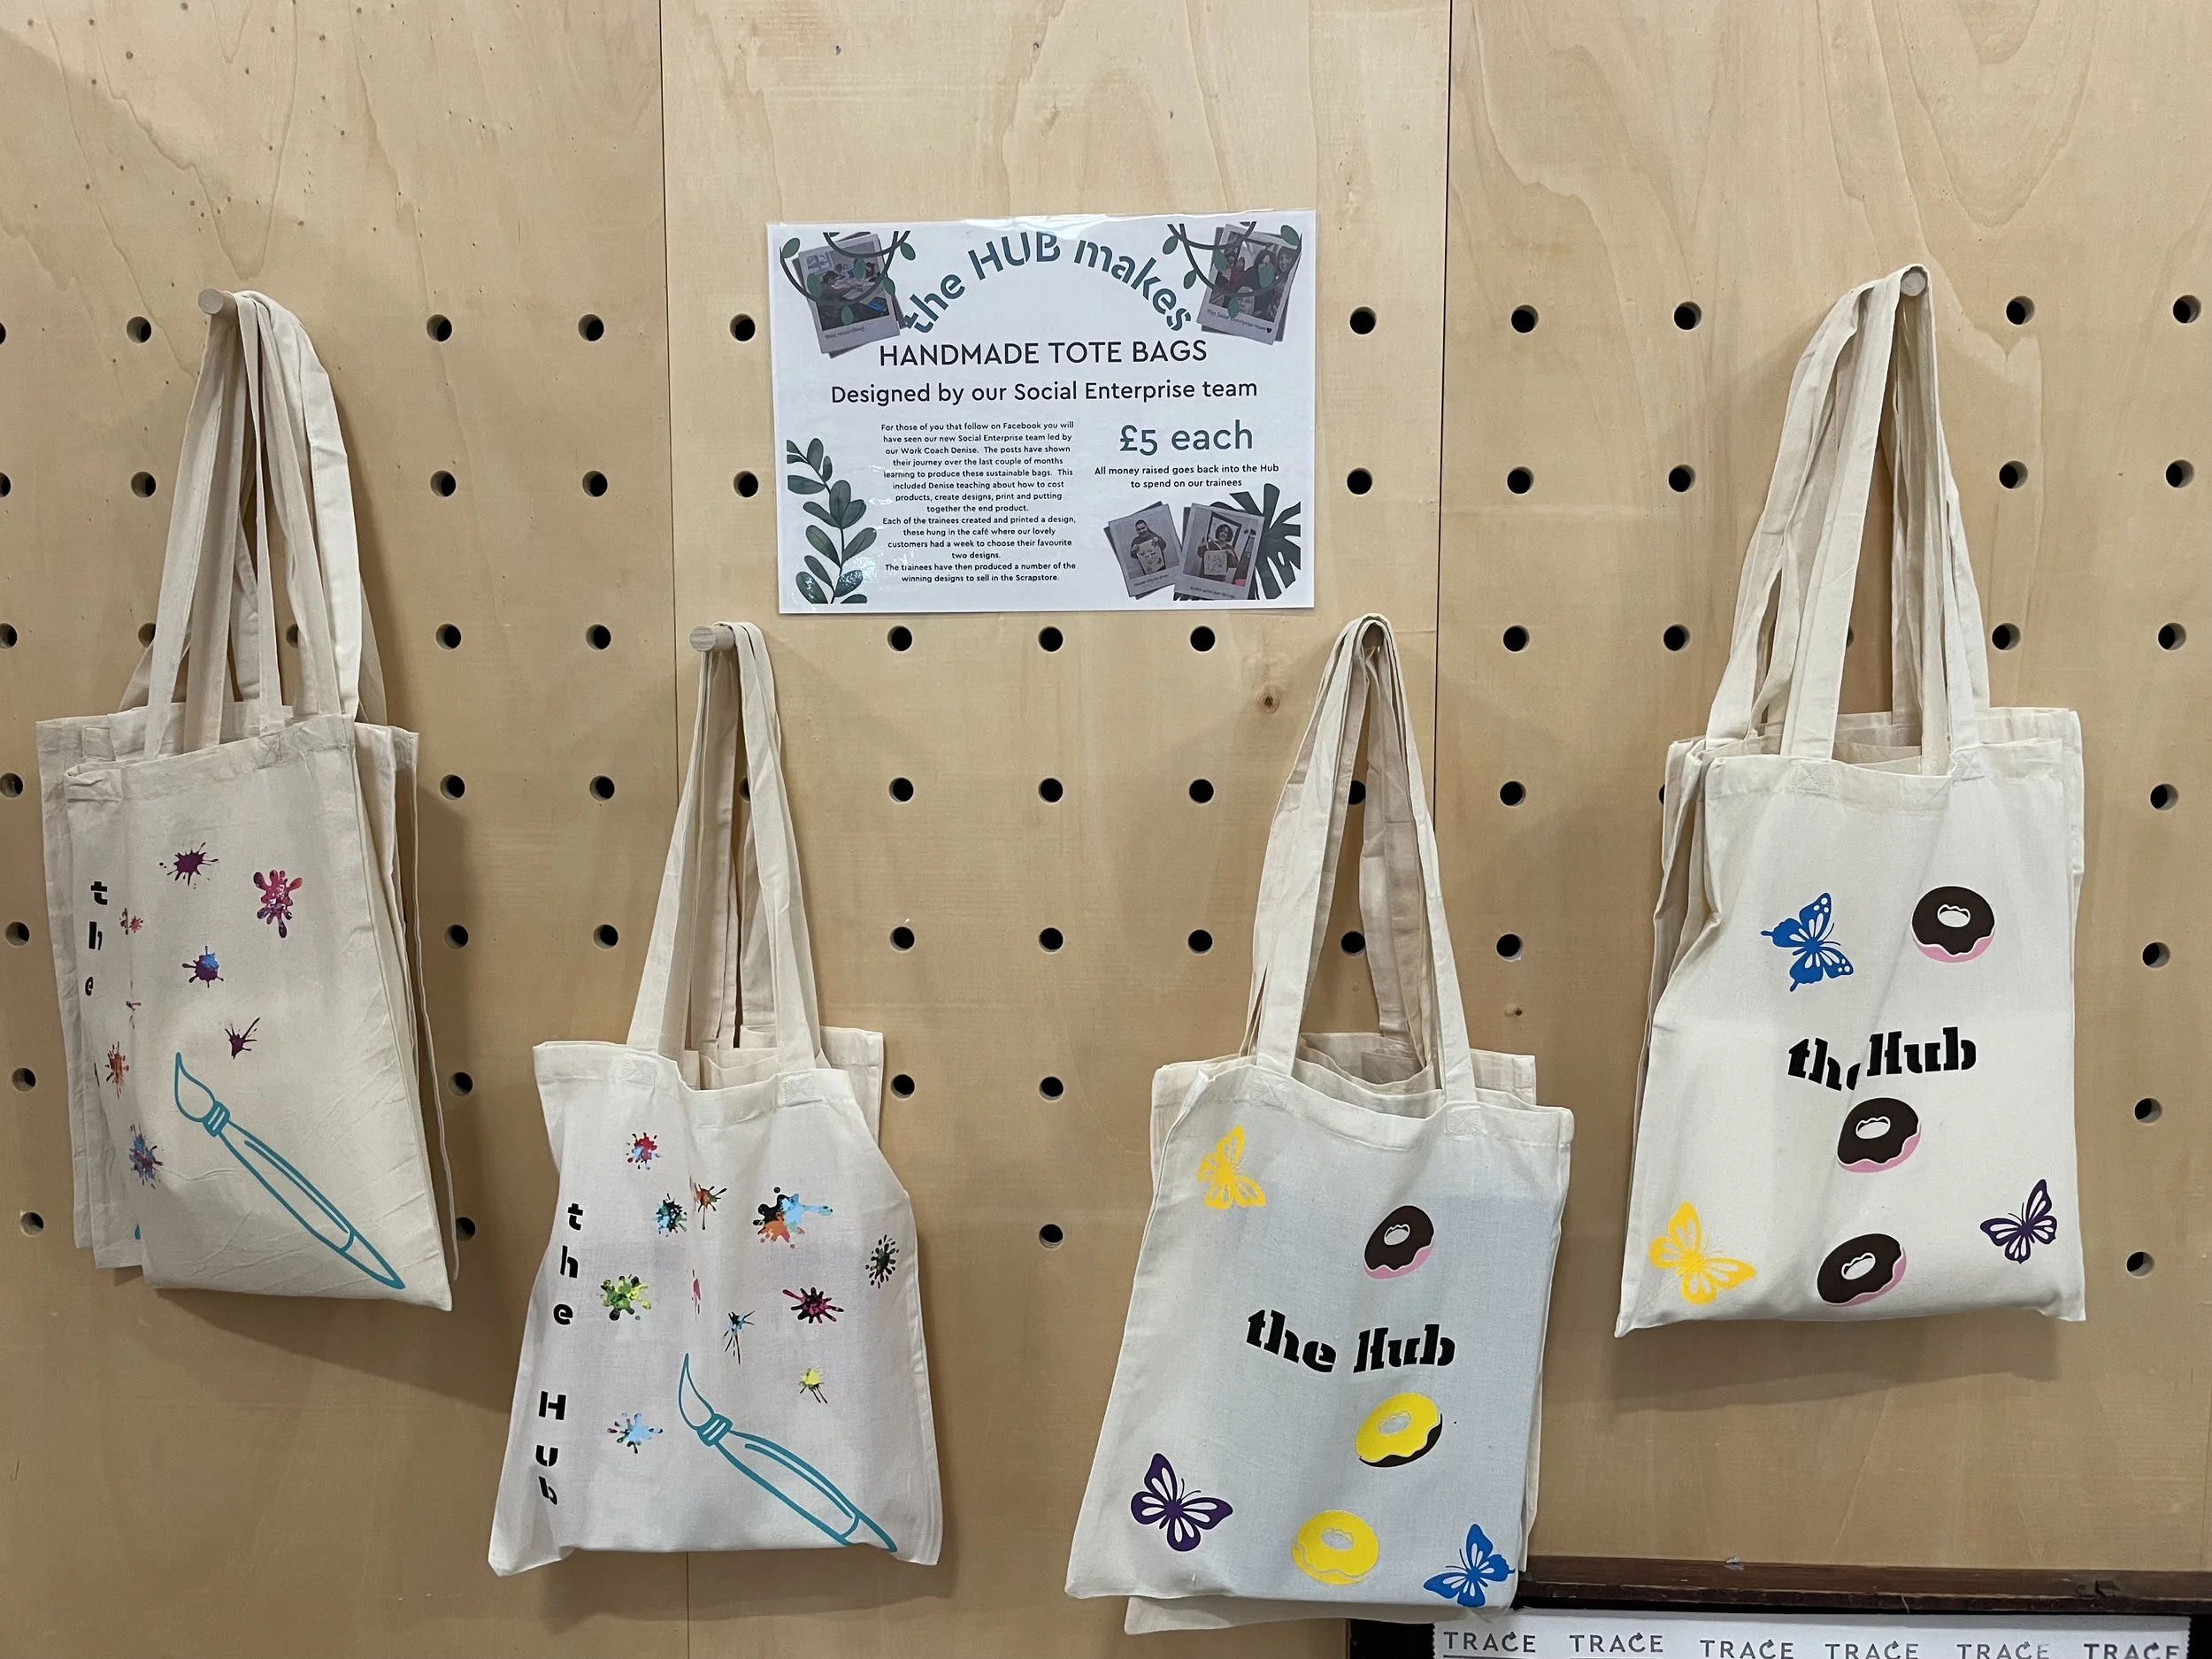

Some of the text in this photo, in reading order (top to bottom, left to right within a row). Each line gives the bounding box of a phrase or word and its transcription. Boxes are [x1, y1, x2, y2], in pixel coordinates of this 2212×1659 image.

[905, 231, 1192, 334] the HUB makes
[879, 340, 1207, 366] HANDMADE TOTE BAGS
[832, 380, 1257, 407] Designed by our Social Enterprise team
[919, 422, 928, 431] of
[946, 422, 963, 431] that
[964, 421, 989, 430] follow
[1002, 421, 1041, 430] Facebook
[883, 434, 902, 443] have
[958, 434, 981, 442] Social
[983, 434, 1024, 442] Enterprise
[1062, 433, 1072, 442] by
[1119, 419, 1253, 457] £5 each
[924, 446, 949, 455] Coach
[1044, 444, 1071, 453] shown
[912, 457, 942, 467] journey
[995, 457, 1022, 466] couple
[883, 470, 915, 480] learning
[927, 470, 961, 479] produce
[962, 469, 984, 478] these
[1032, 468, 1053, 478] bags.
[1094, 463, 1279, 477] All money raised goes back into the Hub
[893, 481, 926, 490] included
[956, 480, 991, 490] teaching
[1130, 480, 1141, 488] to
[1142, 479, 1171, 489] spend
[1205, 478, 1242, 487] trainees
[895, 493, 933, 503] products,
[961, 493, 994, 502] designs,
[926, 504, 961, 514] together
[963, 503, 976, 512] the
[995, 503, 1029, 513] product.
[902, 516, 912, 525] of
[993, 515, 1009, 524] and
[1010, 515, 1039, 525] printed
[1048, 515, 1076, 525] design,
[926, 528, 946, 537] hung
[957, 527, 971, 536] the
[1033, 526, 1056, 536] lovely
[1037, 538, 1072, 547] favourite
[969, 550, 1002, 560] designs.
[885, 563, 900, 572] The
[974, 562, 1012, 572] produced
[1052, 561, 1062, 570] of
[933, 574, 964, 583] designs
[976, 573, 989, 582] sell
[1015, 573, 1059, 582] Scrapstore.
[1866, 1025, 1977, 1077] Hub
[1246, 1309, 1455, 1374] the Hub
[1443, 1631, 2179, 1659] TRACE TRACE TRACE TRACE TRACE TRACE
